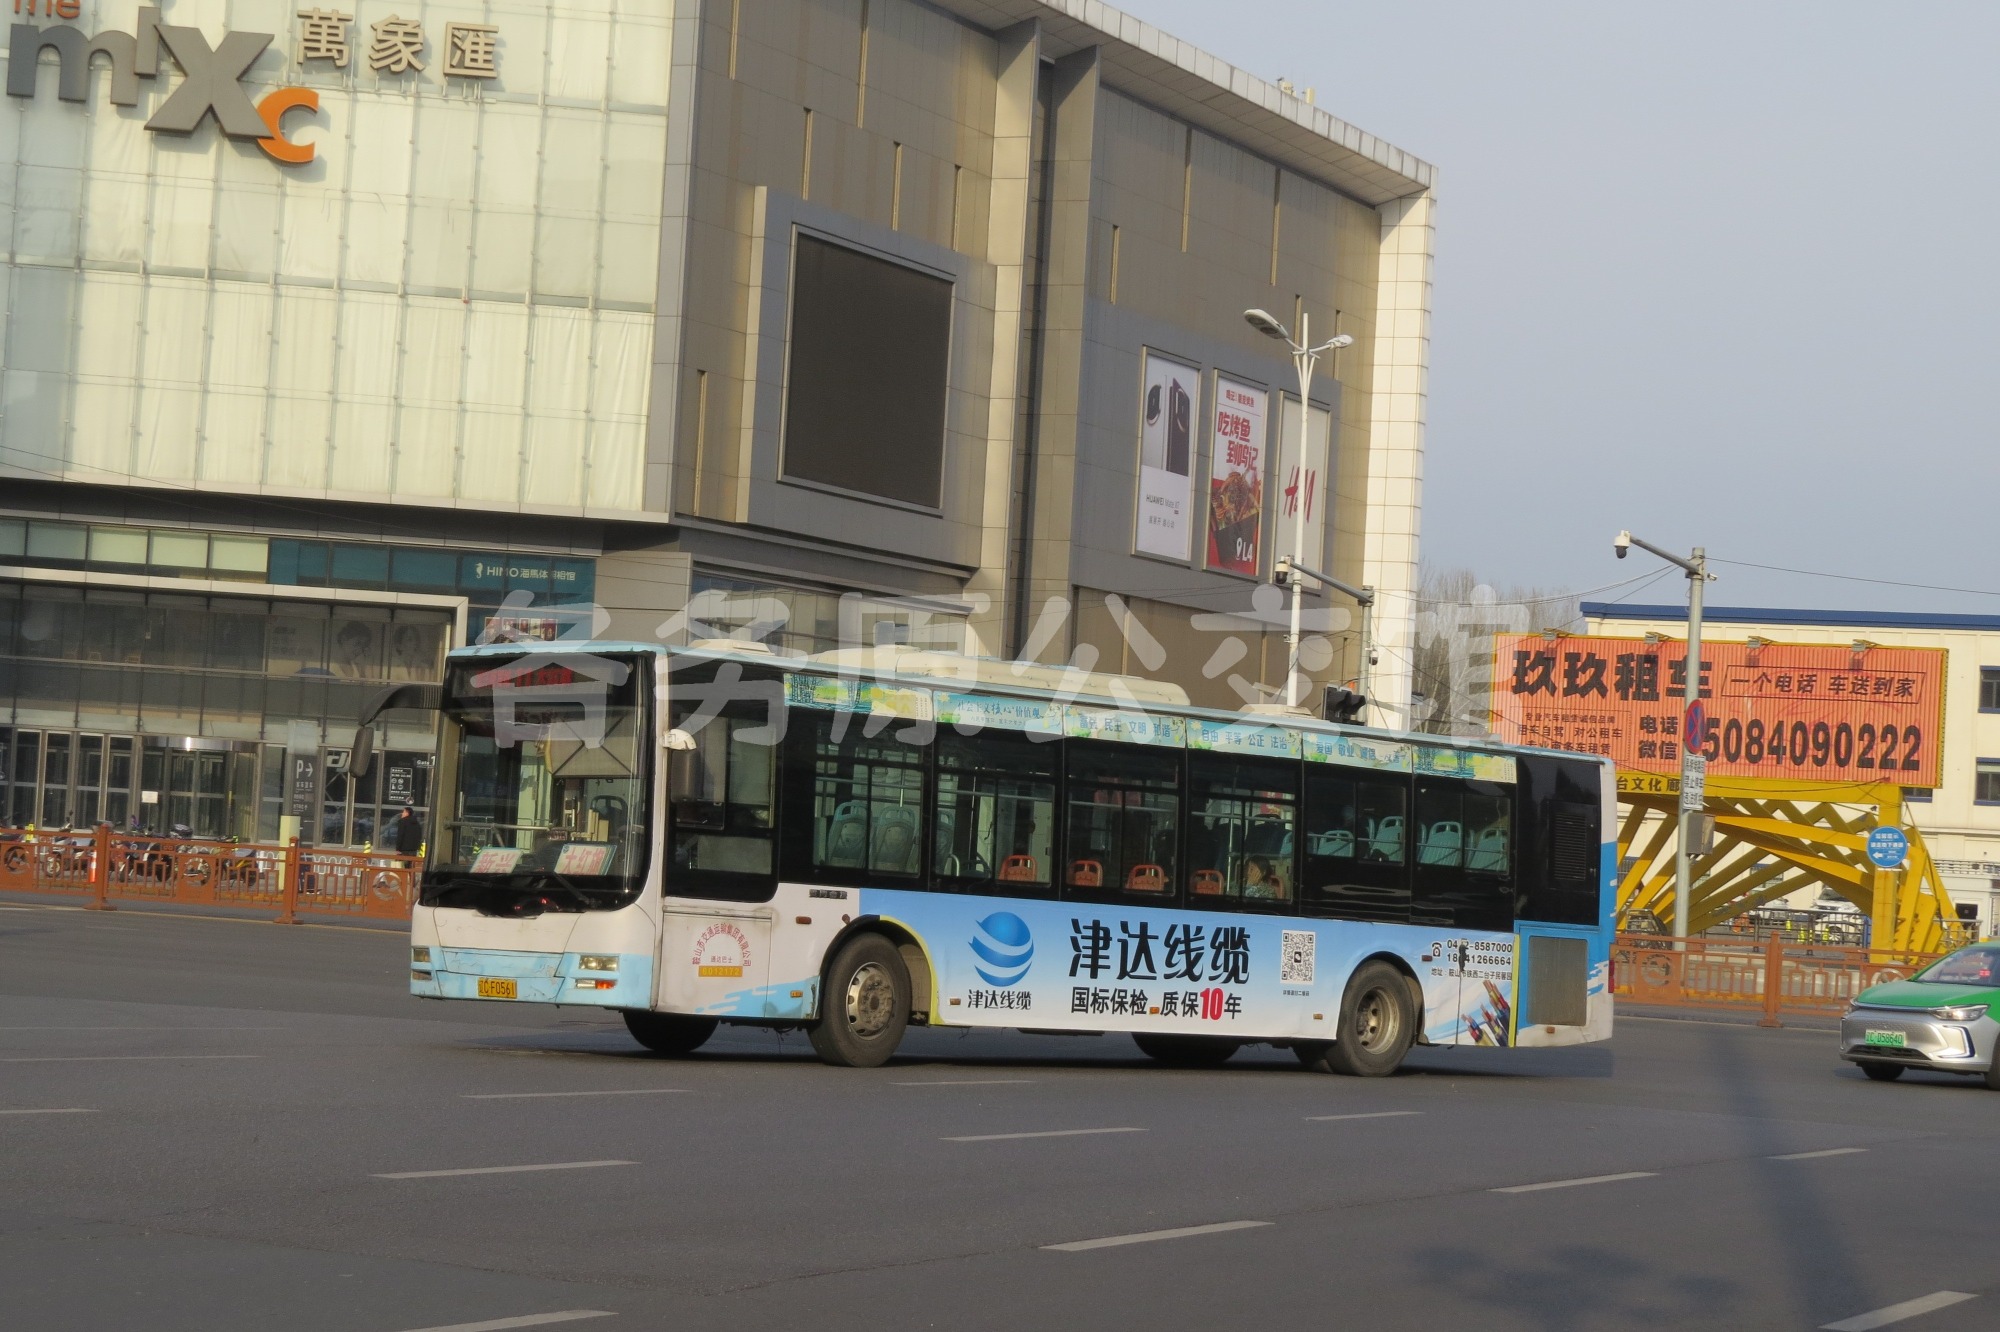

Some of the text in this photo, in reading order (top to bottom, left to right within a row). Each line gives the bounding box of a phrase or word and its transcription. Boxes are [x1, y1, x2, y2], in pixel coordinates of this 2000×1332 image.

[296, 7, 500, 79] 萬象匯
[1217, 411, 1251, 443] 吃烤鱼
[1243, 541, 1253, 562] L4
[1511, 651, 1713, 701] 玖玖租车
[1731, 672, 1916, 697] 一个电话 车送到家
[1104, 718, 1122, 732] 民主
[1129, 720, 1147, 734] 文明
[1154, 723, 1171, 738] 和谐
[1574, 727, 1623, 739] 对公租车
[1640, 714, 1679, 735] 电话
[1202, 729, 1287, 749] 自由 平等 公正 法治
[1316, 742, 1333, 755] 爱国
[1338, 744, 1354, 757] 敬业
[1638, 740, 1678, 760] 微信
[1616, 776, 1681, 792] 台文化廊
[692, 923, 752, 967] 鞍山市交通运输集团有限公司
[1069, 918, 1251, 985] 津达线缆
[1447, 940, 1513, 953] 042-8587000
[1447, 953, 1512, 966] 1841266664
[967, 988, 1032, 1010] 津达线缆
[1070, 986, 1243, 1021] 国标保检 质保10年
